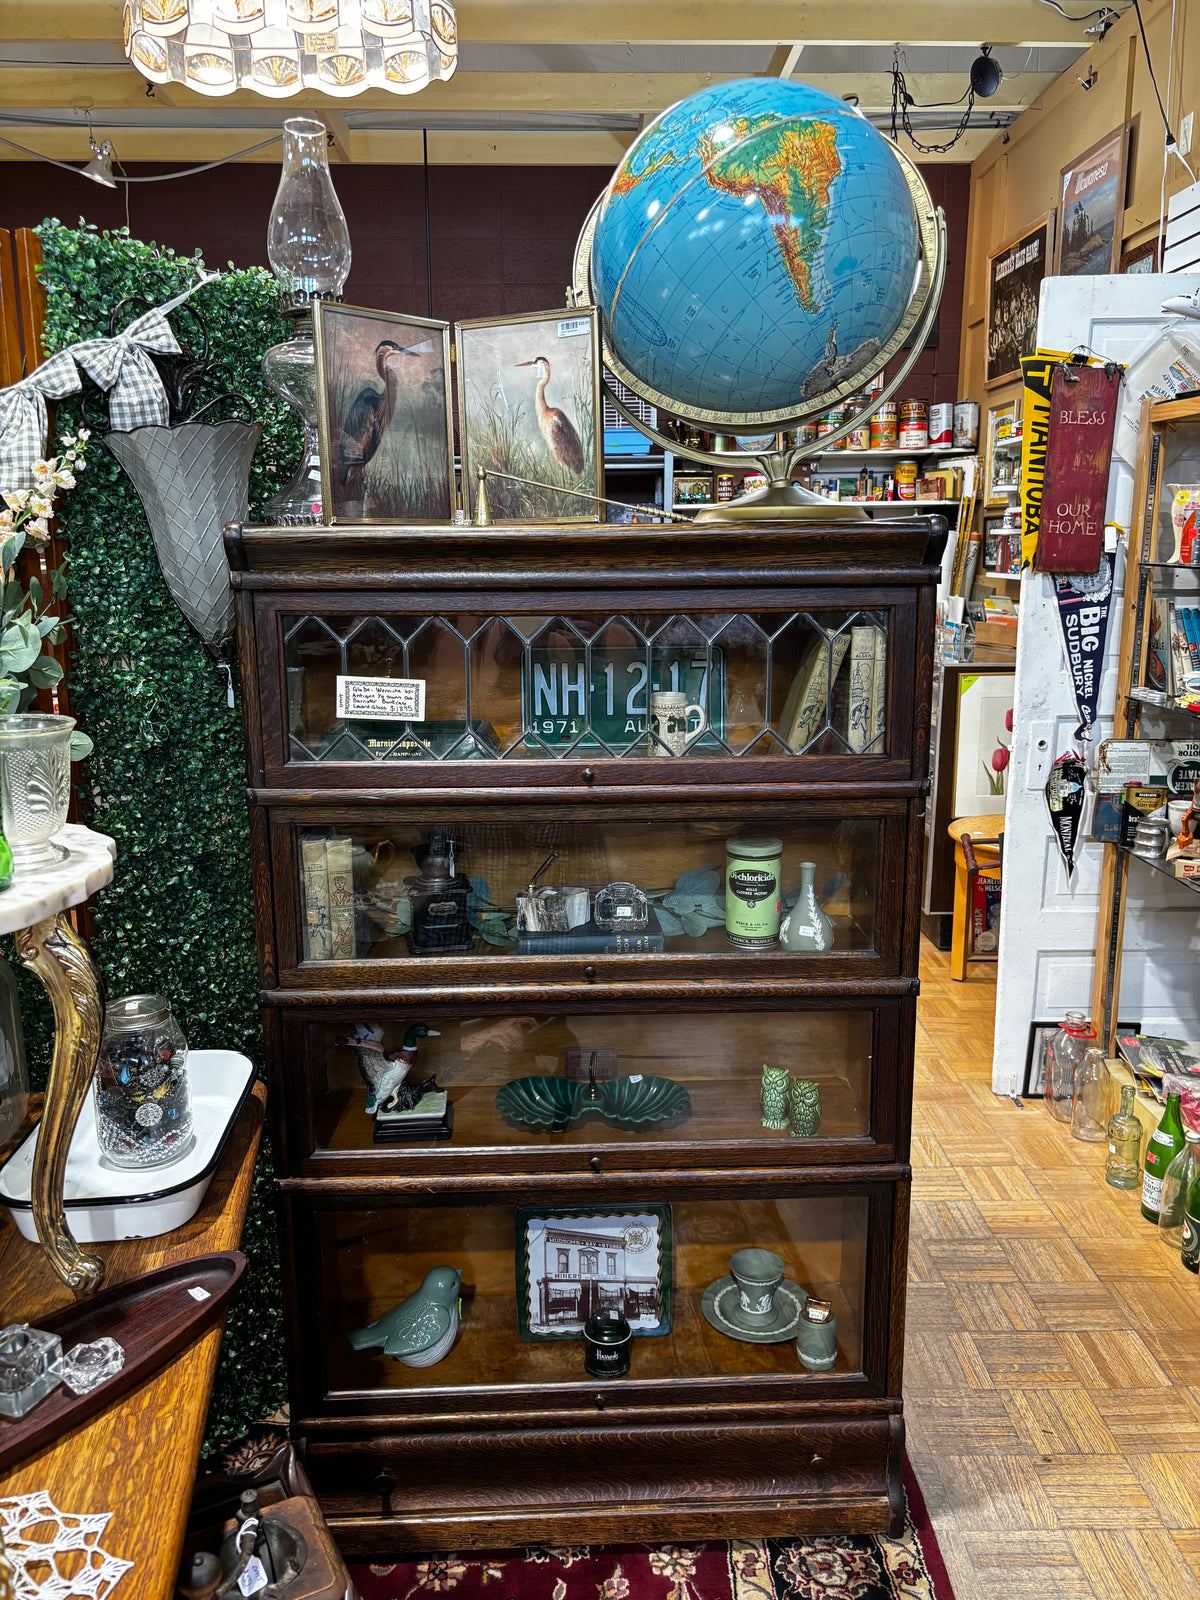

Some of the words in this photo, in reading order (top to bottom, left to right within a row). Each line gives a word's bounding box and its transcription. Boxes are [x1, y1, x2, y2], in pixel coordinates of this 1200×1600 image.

[1074, 162, 1108, 194] Wawanesa
[1162, 373, 1177, 394] VALLEY
[902, 403, 923, 412] CLUB
[1060, 410, 1106, 426] BLESS
[1024, 405, 1050, 536] MANITOBA
[1056, 503, 1091, 518] OUR
[1048, 520, 1096, 536] HOME
[1079, 606, 1100, 652] BIG
[1066, 614, 1084, 697] SUDBURY
[1082, 659, 1094, 700] NICKEL
[532, 720, 580, 734] 1971
[1178, 770, 1199, 780] TATE
[1175, 782, 1195, 790] AKER
[1060, 816, 1072, 852] MONTREAL
[595, 1349, 619, 1360] Harrods
